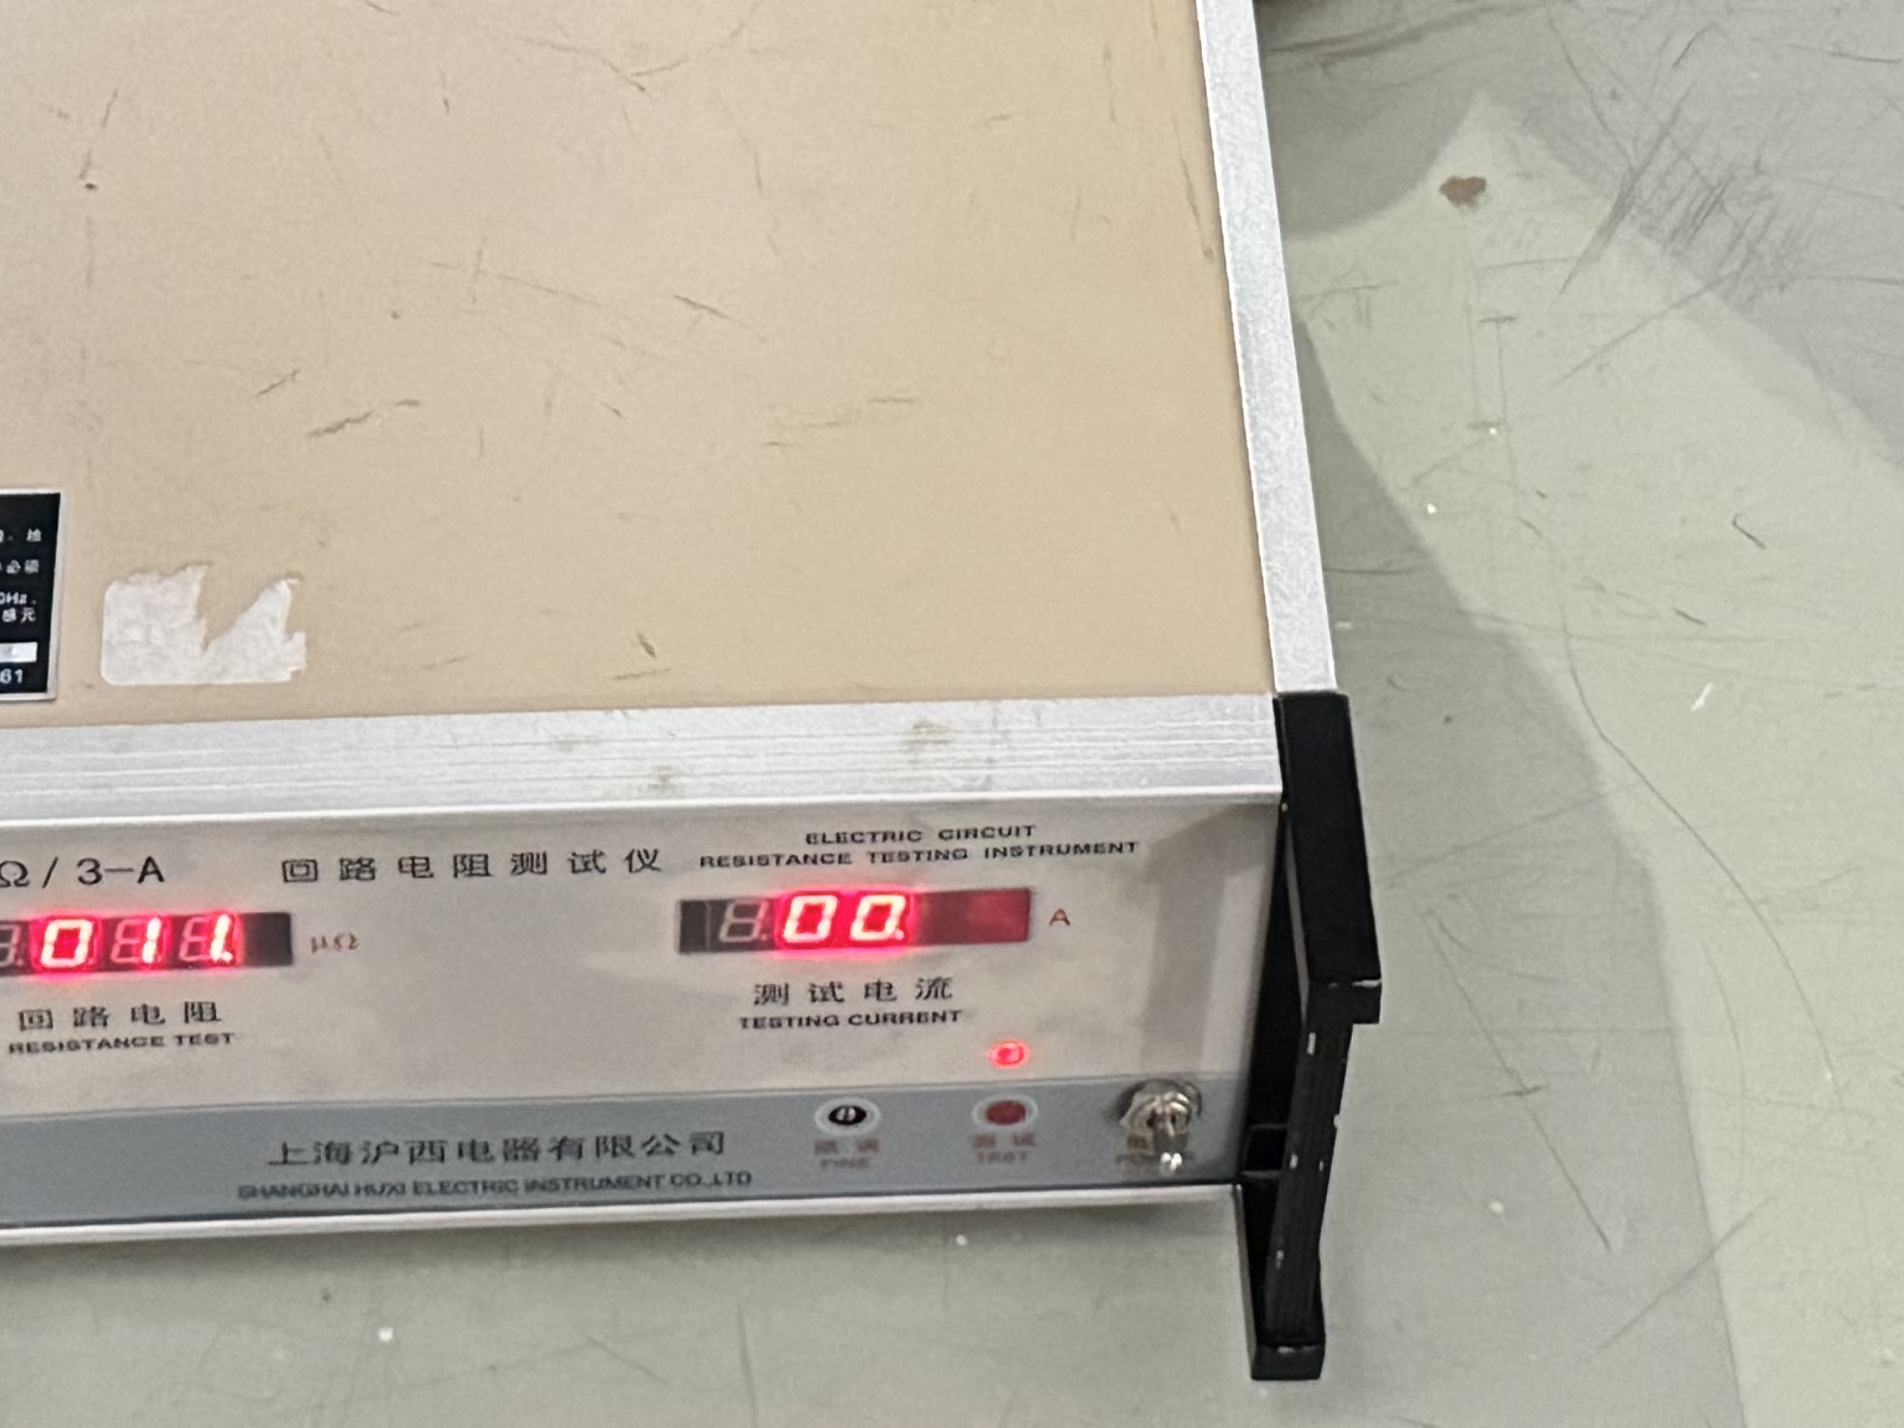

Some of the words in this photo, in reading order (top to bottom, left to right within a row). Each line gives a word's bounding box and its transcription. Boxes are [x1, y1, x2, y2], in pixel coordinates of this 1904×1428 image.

[805, 829, 922, 845] ELECTRIC
[938, 824, 1036, 841] CIRCUIT
[281, 847, 662, 884] 回路电阻测试仪
[699, 852, 853, 869] RESISTANCE
[867, 847, 968, 864] TESTING
[983, 841, 1140, 859] INSTRUMENT
[1049, 907, 1072, 927] A
[753, 976, 954, 1006] 测试电流
[17, 1001, 222, 1032] 回路电阻
[738, 1012, 841, 1030] TESTING
[847, 1009, 964, 1027] CURRENT
[8, 1034, 165, 1054] RESISTANCE
[175, 1032, 235, 1046] TEST
[266, 1130, 726, 1166] 上海沪西电器有限公司
[237, 1182, 349, 1200] SHANGHAI
[412, 1178, 519, 1196] ELECTRIC
[524, 1174, 666, 1194] INSTRUMENT
